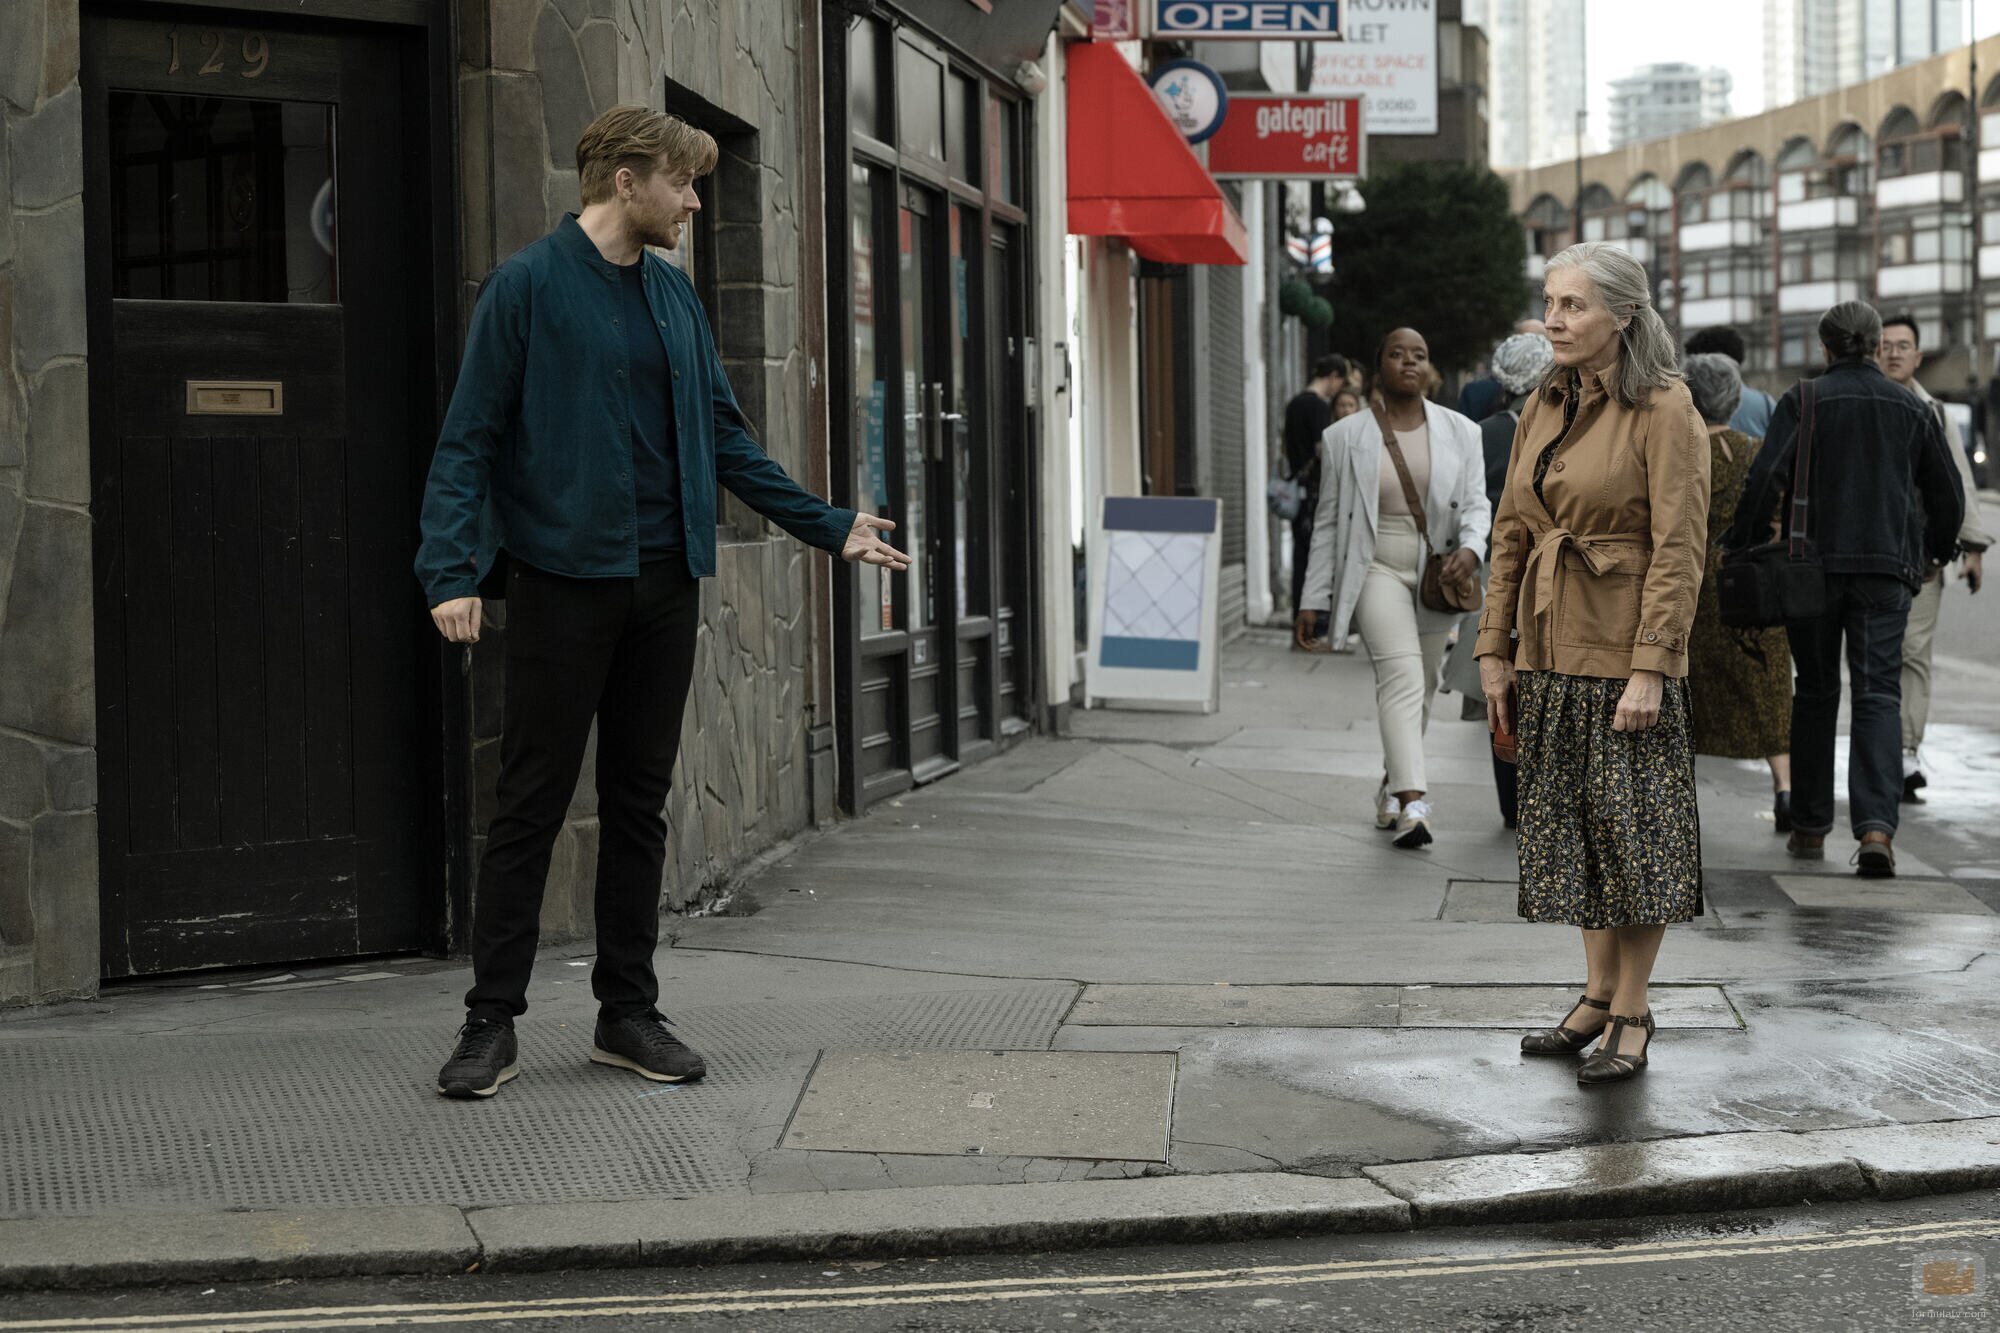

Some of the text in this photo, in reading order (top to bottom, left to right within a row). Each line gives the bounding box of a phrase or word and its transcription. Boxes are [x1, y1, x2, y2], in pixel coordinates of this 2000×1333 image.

[1163, 2, 1330, 31] OPEN
[1348, 23, 1388, 43] LET
[167, 28, 269, 78] 129
[1374, 54, 1426, 69] SPACE
[1256, 99, 1346, 139] gategrill
[1302, 134, 1350, 171] café
